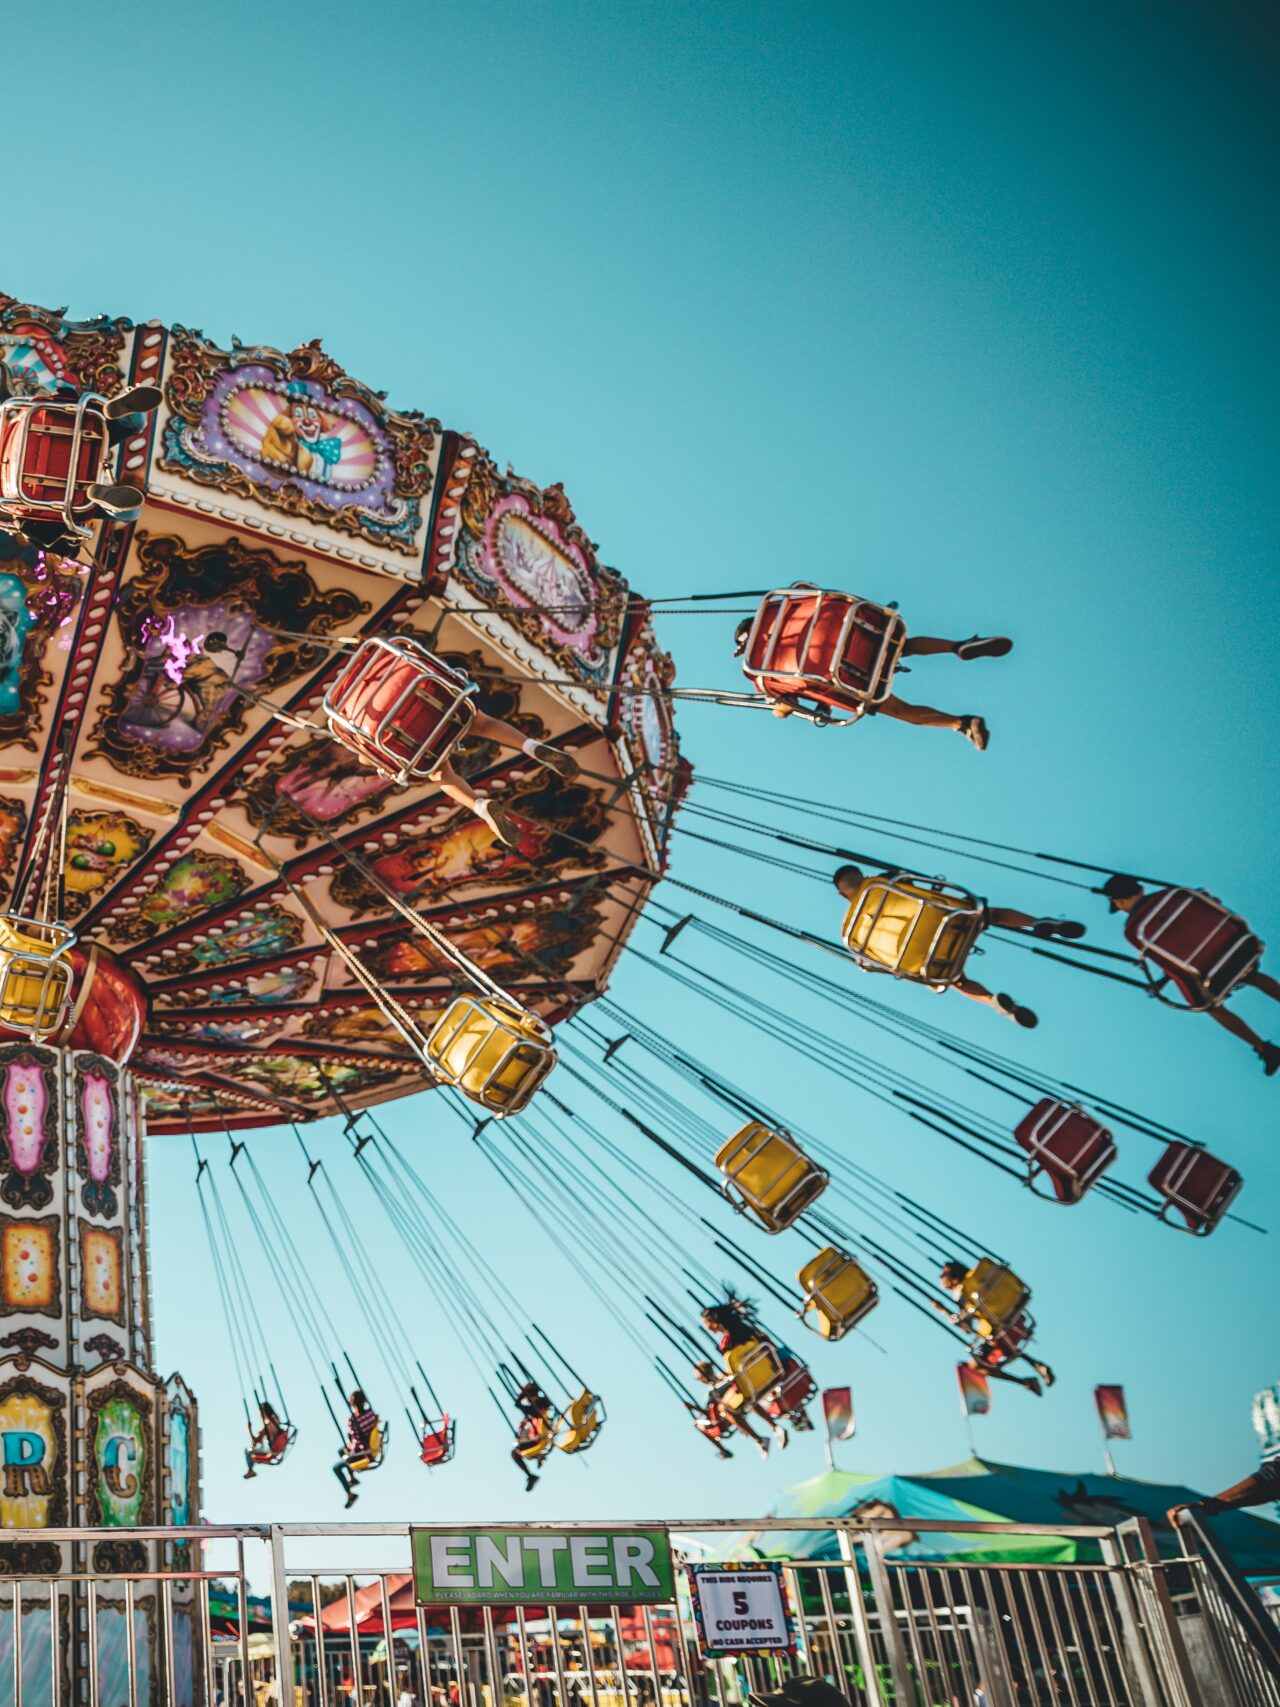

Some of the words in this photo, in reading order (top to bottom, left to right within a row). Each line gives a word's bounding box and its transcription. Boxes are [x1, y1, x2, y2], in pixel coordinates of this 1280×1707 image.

[428, 1535, 662, 1588] ENTER
[737, 1575, 772, 1583] REQUIRES
[732, 1591, 750, 1615] 5
[715, 1618, 774, 1631] COUPONS
[725, 1638, 745, 1646] CASH
